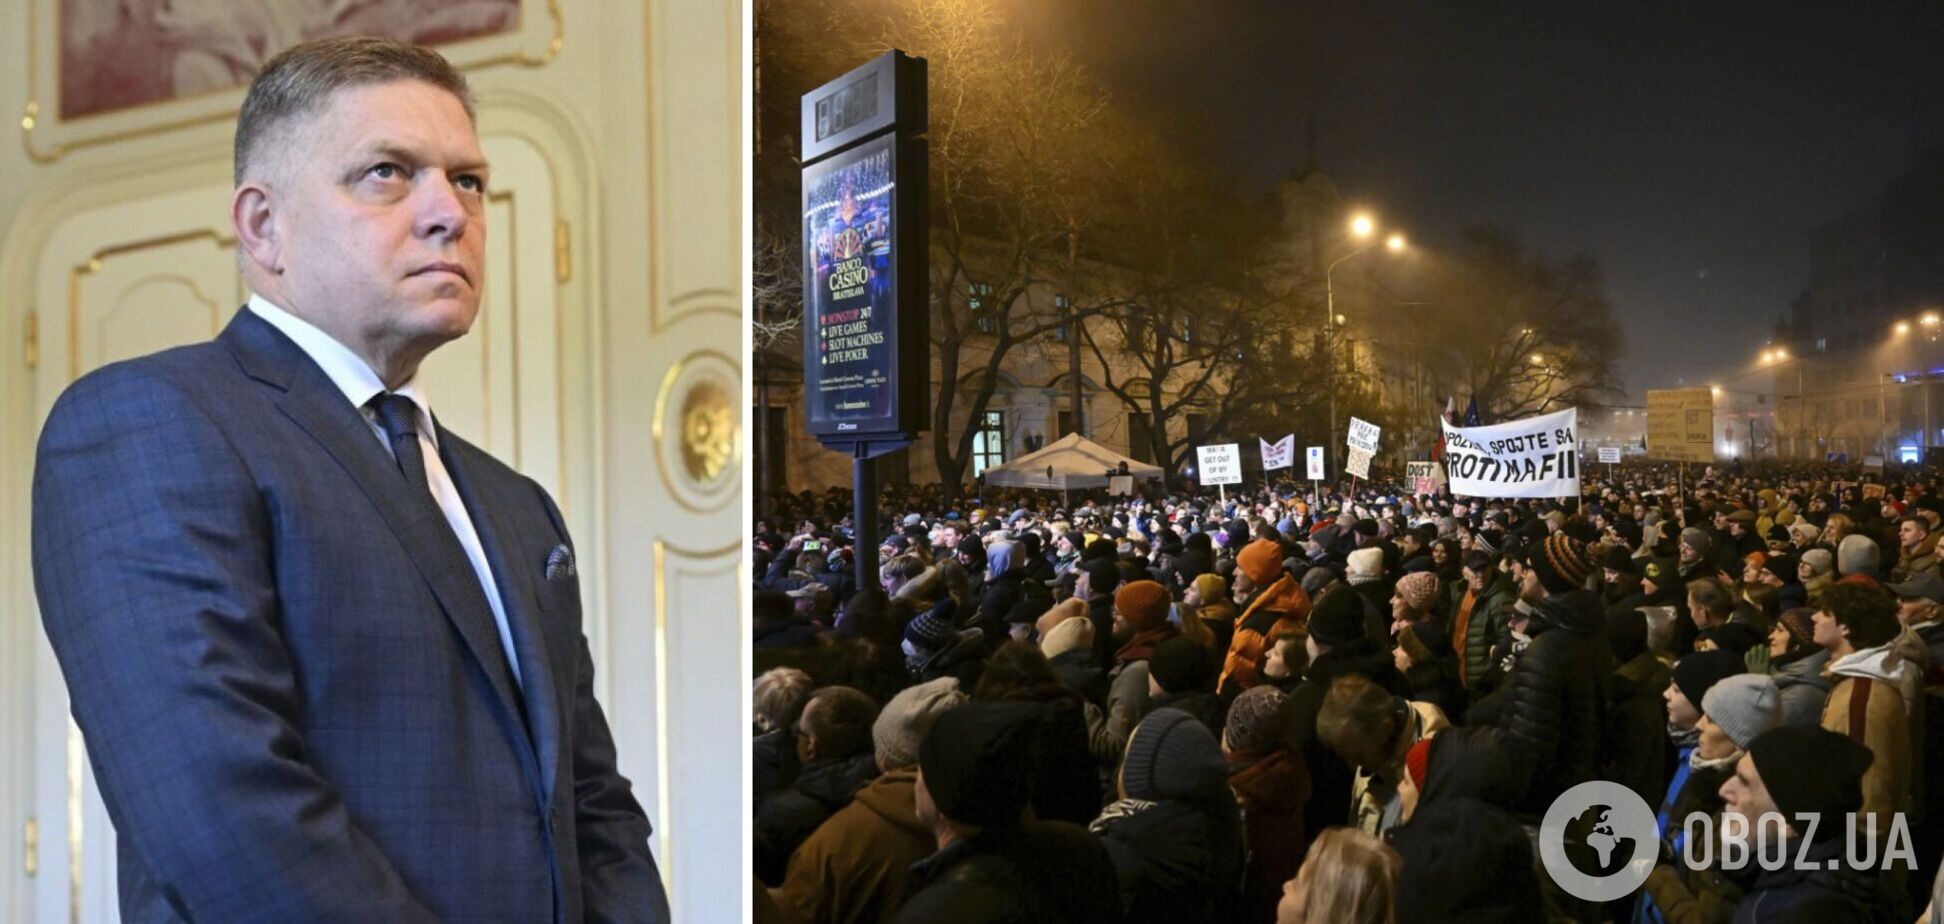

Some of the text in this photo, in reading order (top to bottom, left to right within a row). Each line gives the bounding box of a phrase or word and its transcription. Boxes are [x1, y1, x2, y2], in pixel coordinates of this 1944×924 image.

[836, 257, 861, 274] BANCO
[829, 266, 868, 291] CASINO
[828, 320, 867, 339] LIVE GAMES
[828, 331, 884, 351] SLOT MACHINES
[829, 347, 868, 364] LIVE POKER
[1489, 432, 1548, 455] SPOJTE
[1555, 427, 1574, 445] SA
[1204, 455, 1229, 464] GET OUT
[1503, 450, 1576, 483] MAFII
